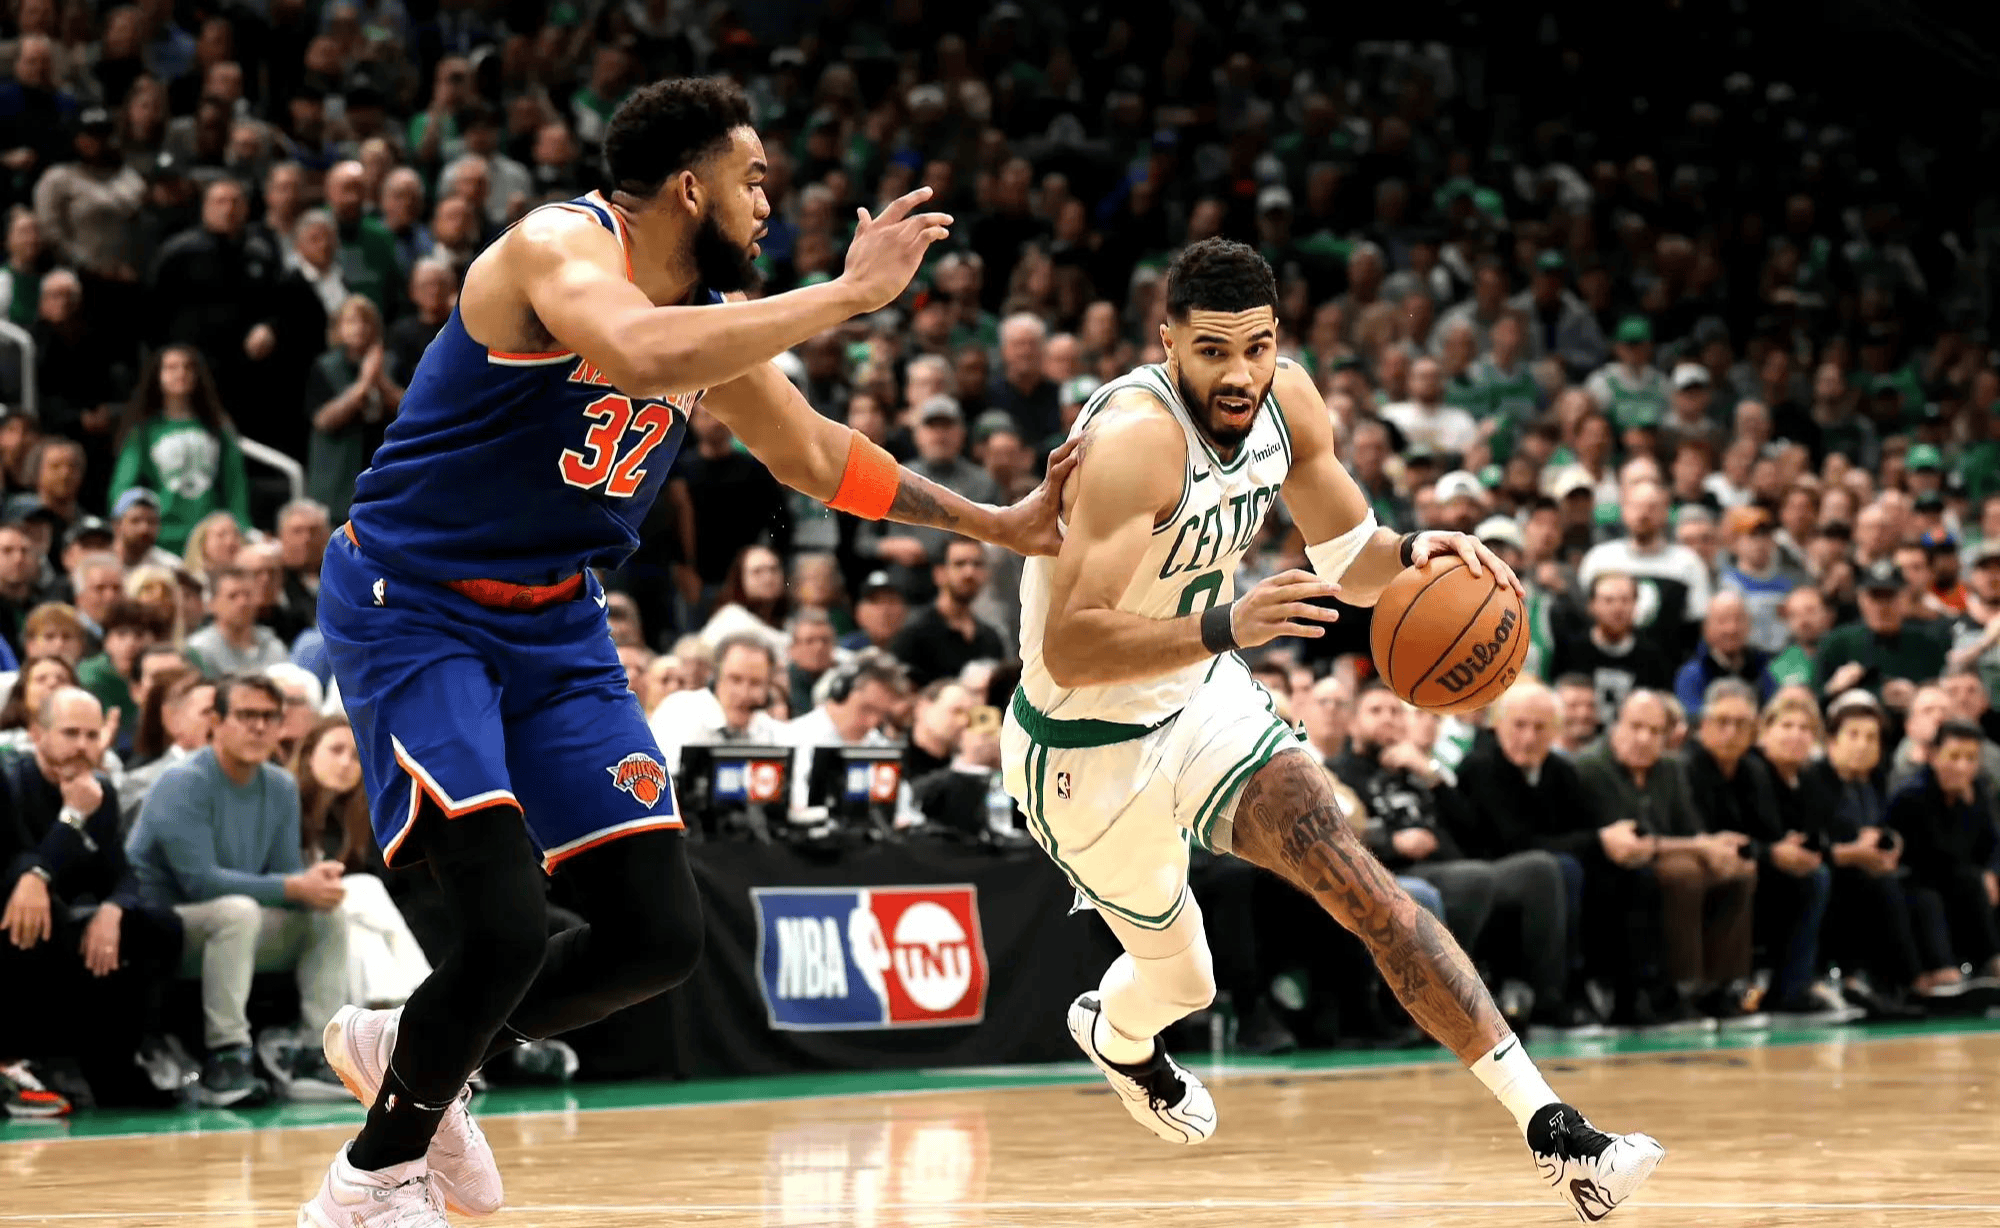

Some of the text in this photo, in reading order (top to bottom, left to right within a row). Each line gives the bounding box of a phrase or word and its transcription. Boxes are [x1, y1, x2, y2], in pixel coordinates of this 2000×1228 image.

[558, 393, 673, 497] 32
[1252, 442, 1281, 465] Amica
[1435, 608, 1516, 692] Wilson
[776, 916, 848, 999] NBA
